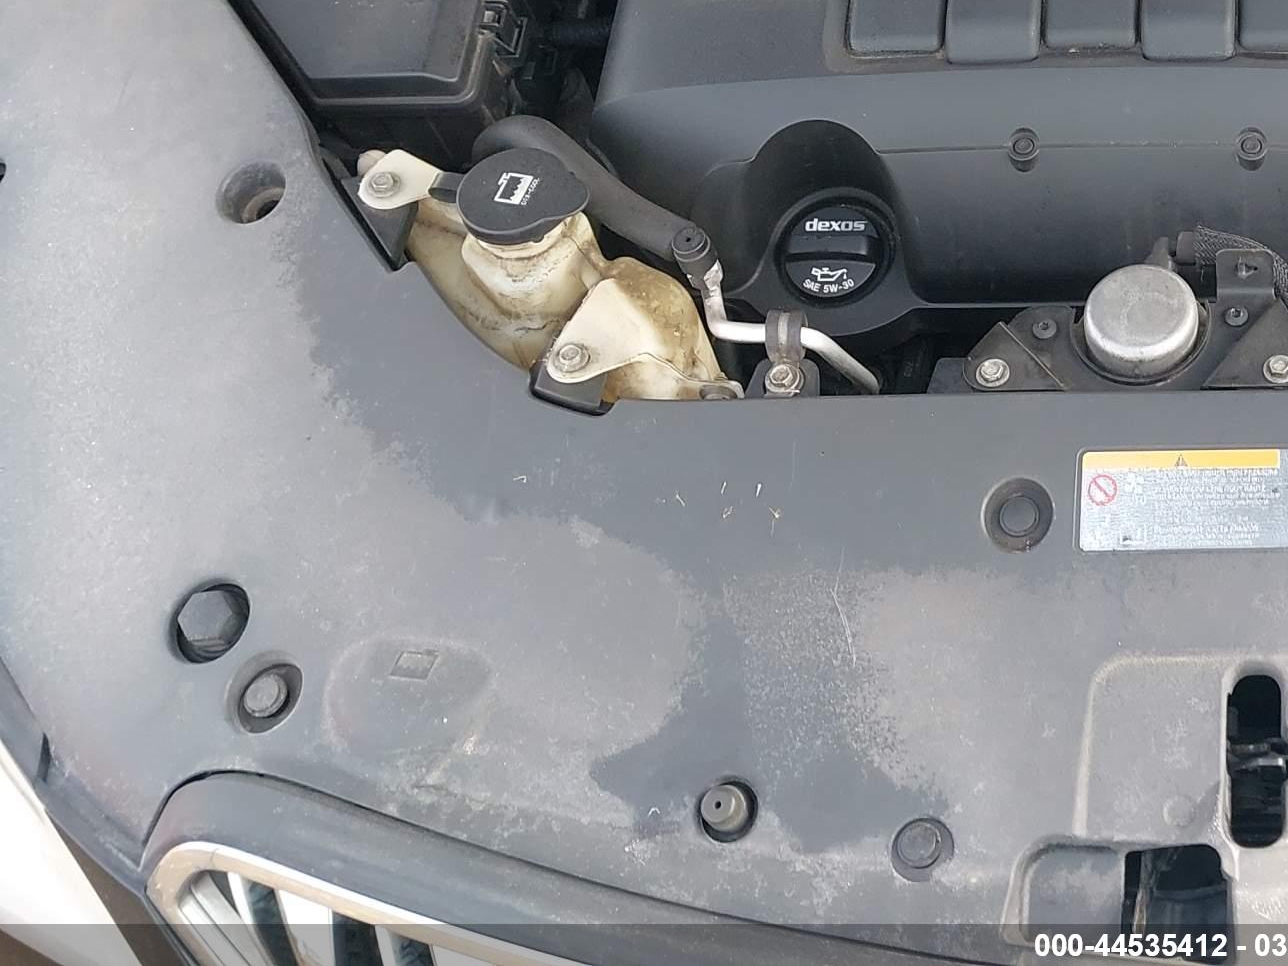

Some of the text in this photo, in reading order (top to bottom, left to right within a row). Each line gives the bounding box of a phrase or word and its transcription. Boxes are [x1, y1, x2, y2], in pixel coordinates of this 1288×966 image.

[804, 218, 868, 232] dexos
[803, 279, 854, 293] SAE 5W-30
